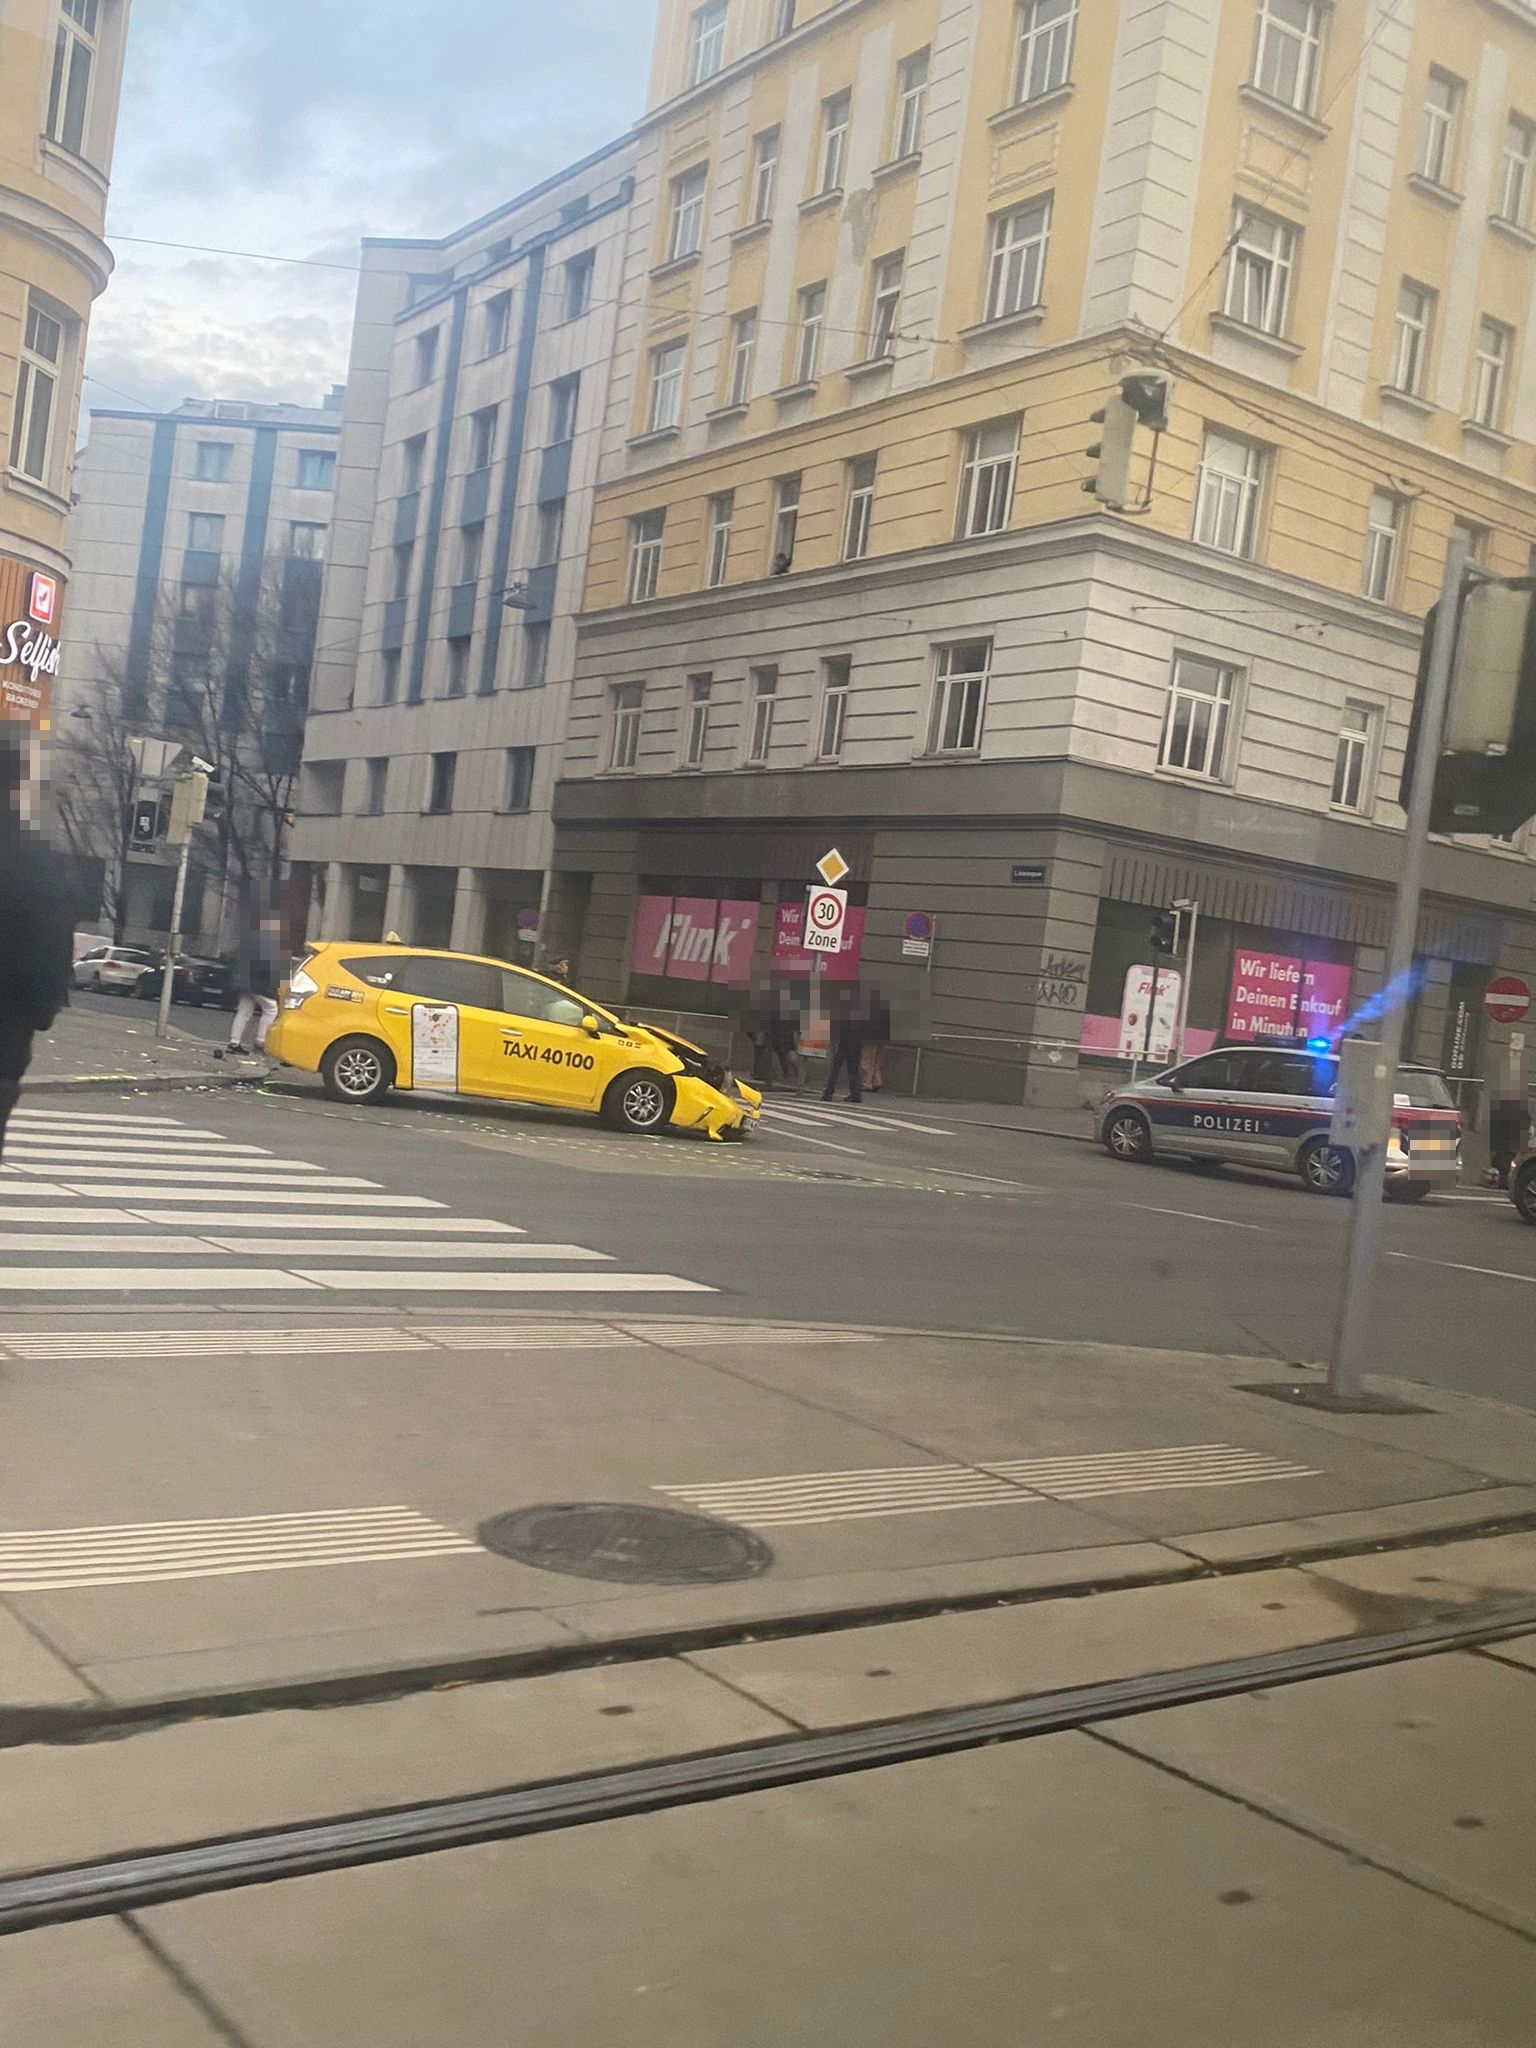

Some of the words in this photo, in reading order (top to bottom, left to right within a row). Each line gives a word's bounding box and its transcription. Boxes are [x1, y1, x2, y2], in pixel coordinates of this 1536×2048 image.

[782, 909, 800, 923] Wir
[817, 902, 835, 921] 30
[653, 912, 739, 966] Flink
[808, 930, 837, 948] Zone
[1240, 958, 1267, 978] Wir
[1236, 985, 1286, 1009] Deinen
[1289, 993, 1342, 1016] Enkauf
[1232, 1012, 1246, 1030] in
[503, 1040, 538, 1061] TAXI
[1193, 1114, 1259, 1133] POLIZEI
